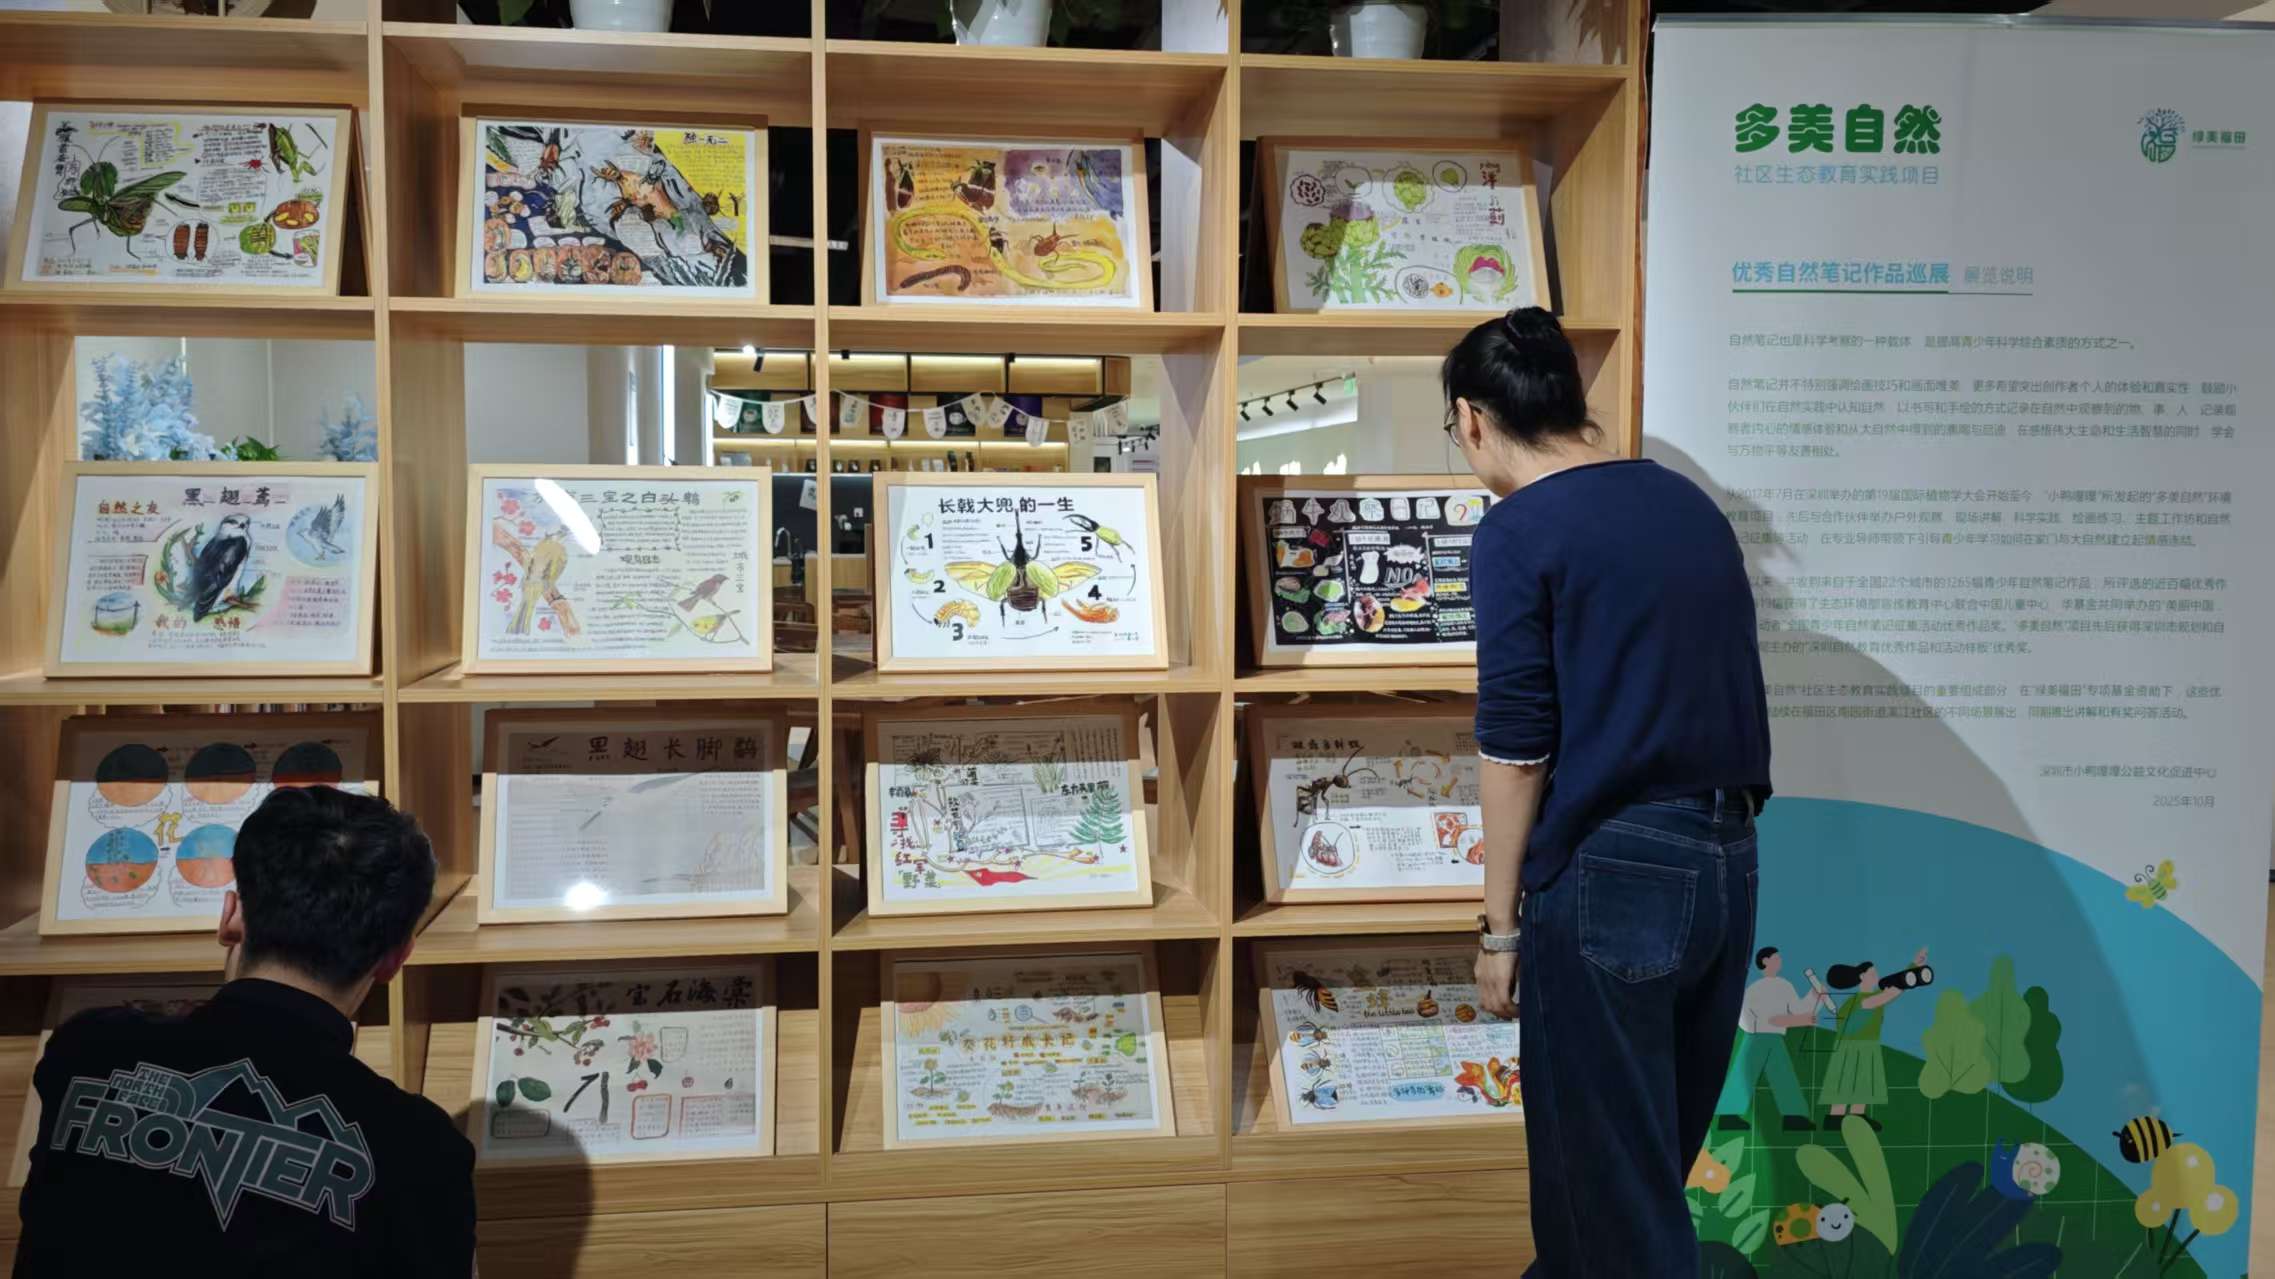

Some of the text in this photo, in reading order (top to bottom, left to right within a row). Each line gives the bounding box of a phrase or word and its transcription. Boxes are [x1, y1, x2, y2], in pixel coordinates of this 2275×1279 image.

[1735, 103, 1942, 154] 多美自然
[2192, 130, 2247, 144] 绿美福田
[1735, 165, 1939, 185] 社区生态教育实践项目
[1732, 262, 2034, 286] 优秀自然笔记作品巡展 展览说明
[185, 486, 271, 507] 黑翅鸢
[938, 497, 1075, 514] 长戟大兜的一生
[925, 533, 935, 549] 1
[1081, 536, 1093, 551] 5
[1385, 566, 1414, 583] NO
[934, 581, 946, 593] 2
[1088, 584, 1102, 600] 4
[952, 622, 964, 641] 3
[2152, 795, 2215, 808] 2025年10月
[626, 976, 753, 1008] 宝石海棠
[138, 1067, 170, 1087] THE
[51, 1077, 374, 1231] FRONTIER
